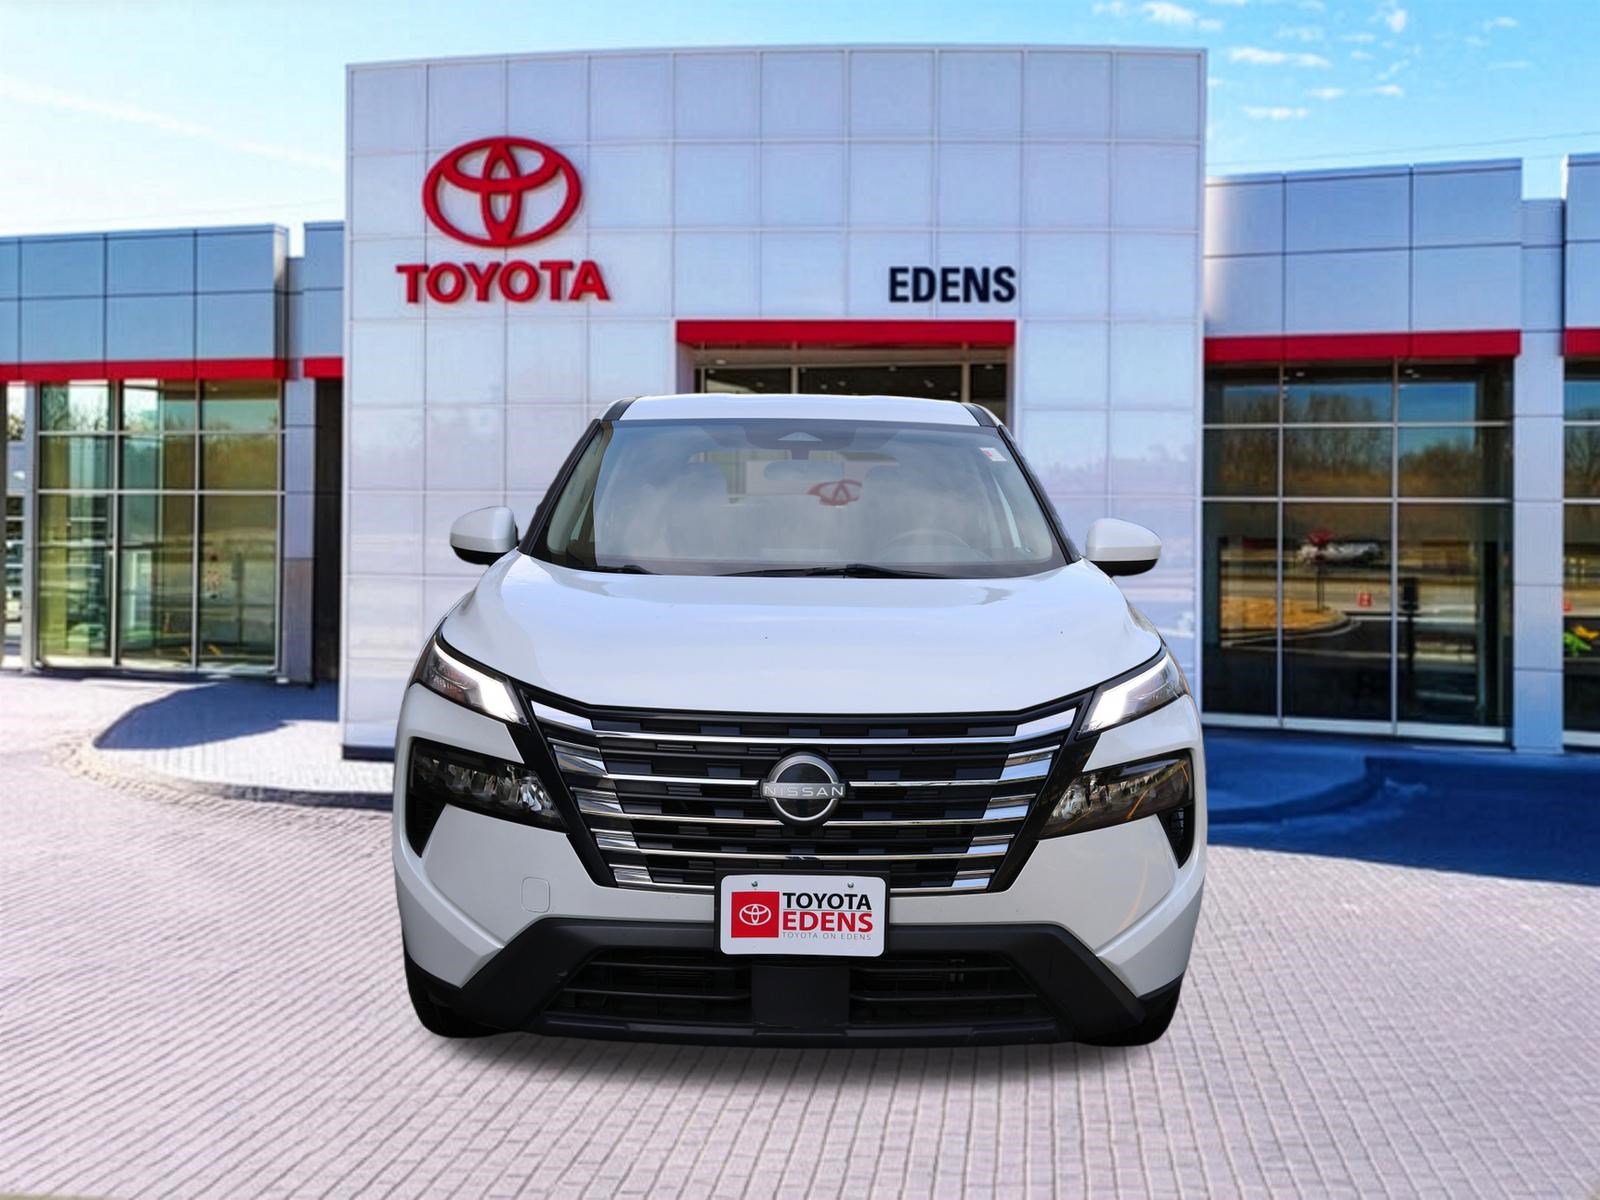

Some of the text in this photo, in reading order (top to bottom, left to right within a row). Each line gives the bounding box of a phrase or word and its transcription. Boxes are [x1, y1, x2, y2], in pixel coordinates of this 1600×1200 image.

[396, 259, 611, 303] TOYOTA
[888, 266, 1017, 303] EDENS
[764, 786, 844, 796] NISSAN
[782, 893, 872, 910] TOYOTA
[782, 911, 873, 932] EDENS
[782, 932, 871, 941] TOYOTA ON EDENS
